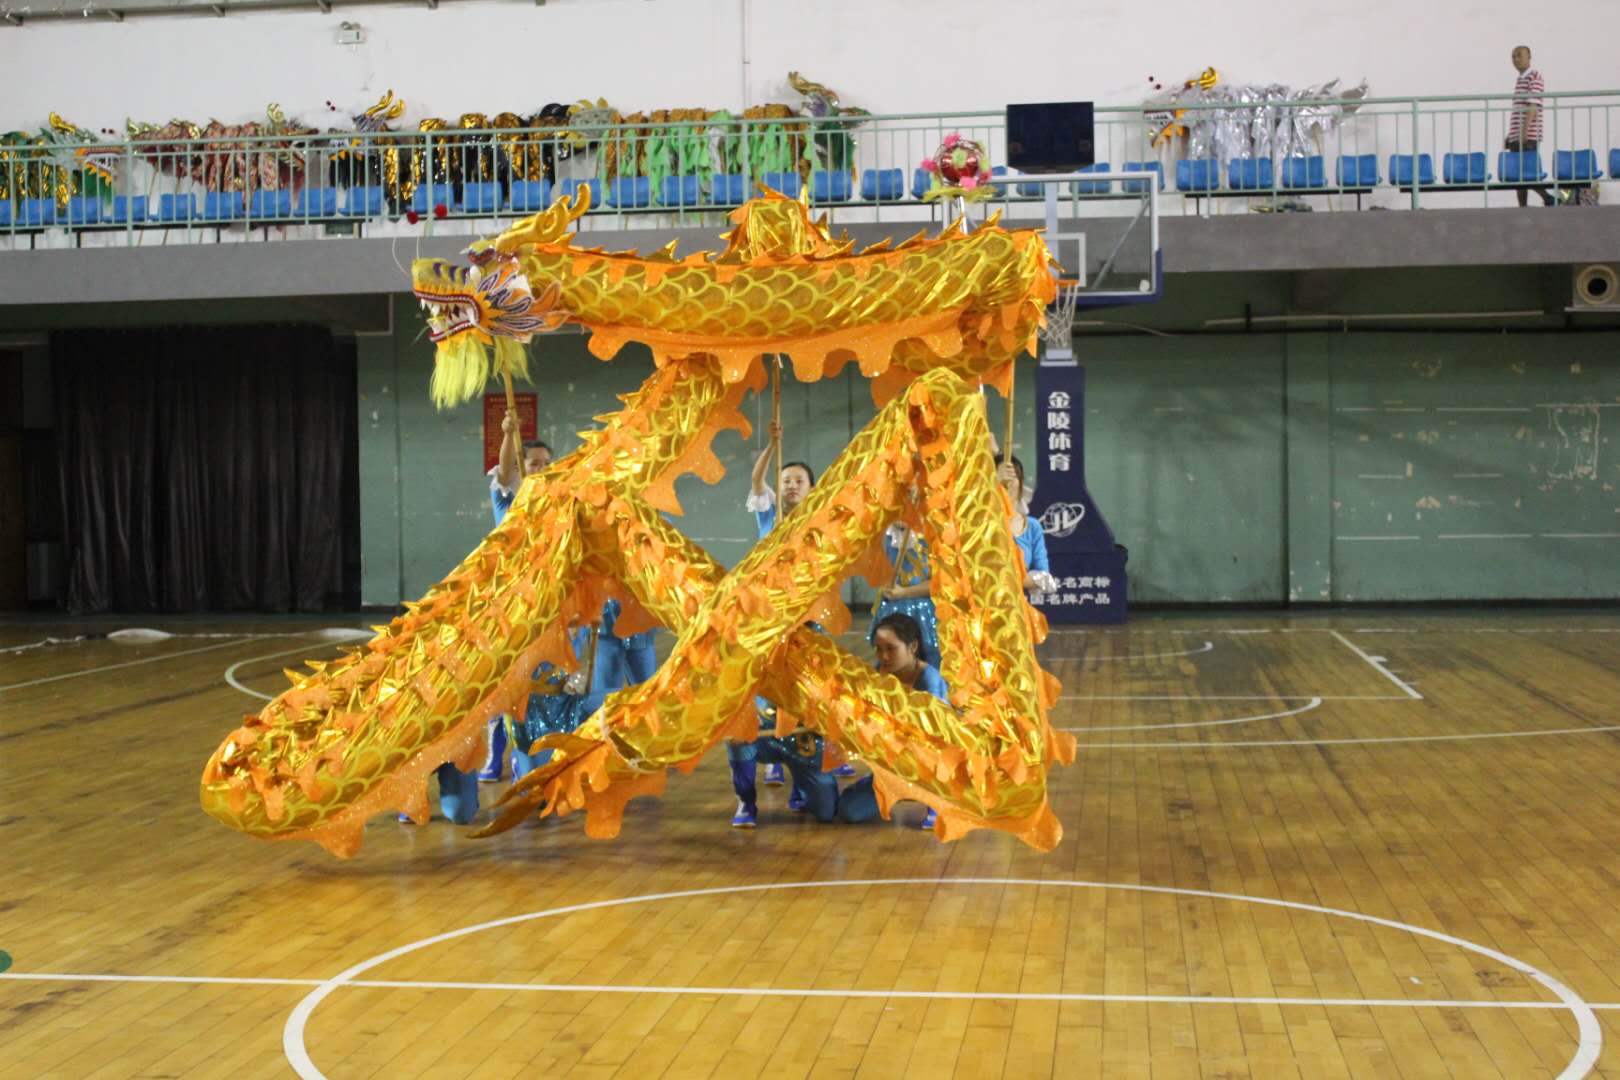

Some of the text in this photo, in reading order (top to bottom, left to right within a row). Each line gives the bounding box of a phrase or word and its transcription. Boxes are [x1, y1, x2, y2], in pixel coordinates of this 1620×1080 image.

[1047, 391, 1072, 472] 金陵体育
[1026, 593, 1111, 605] 国名牌产品
